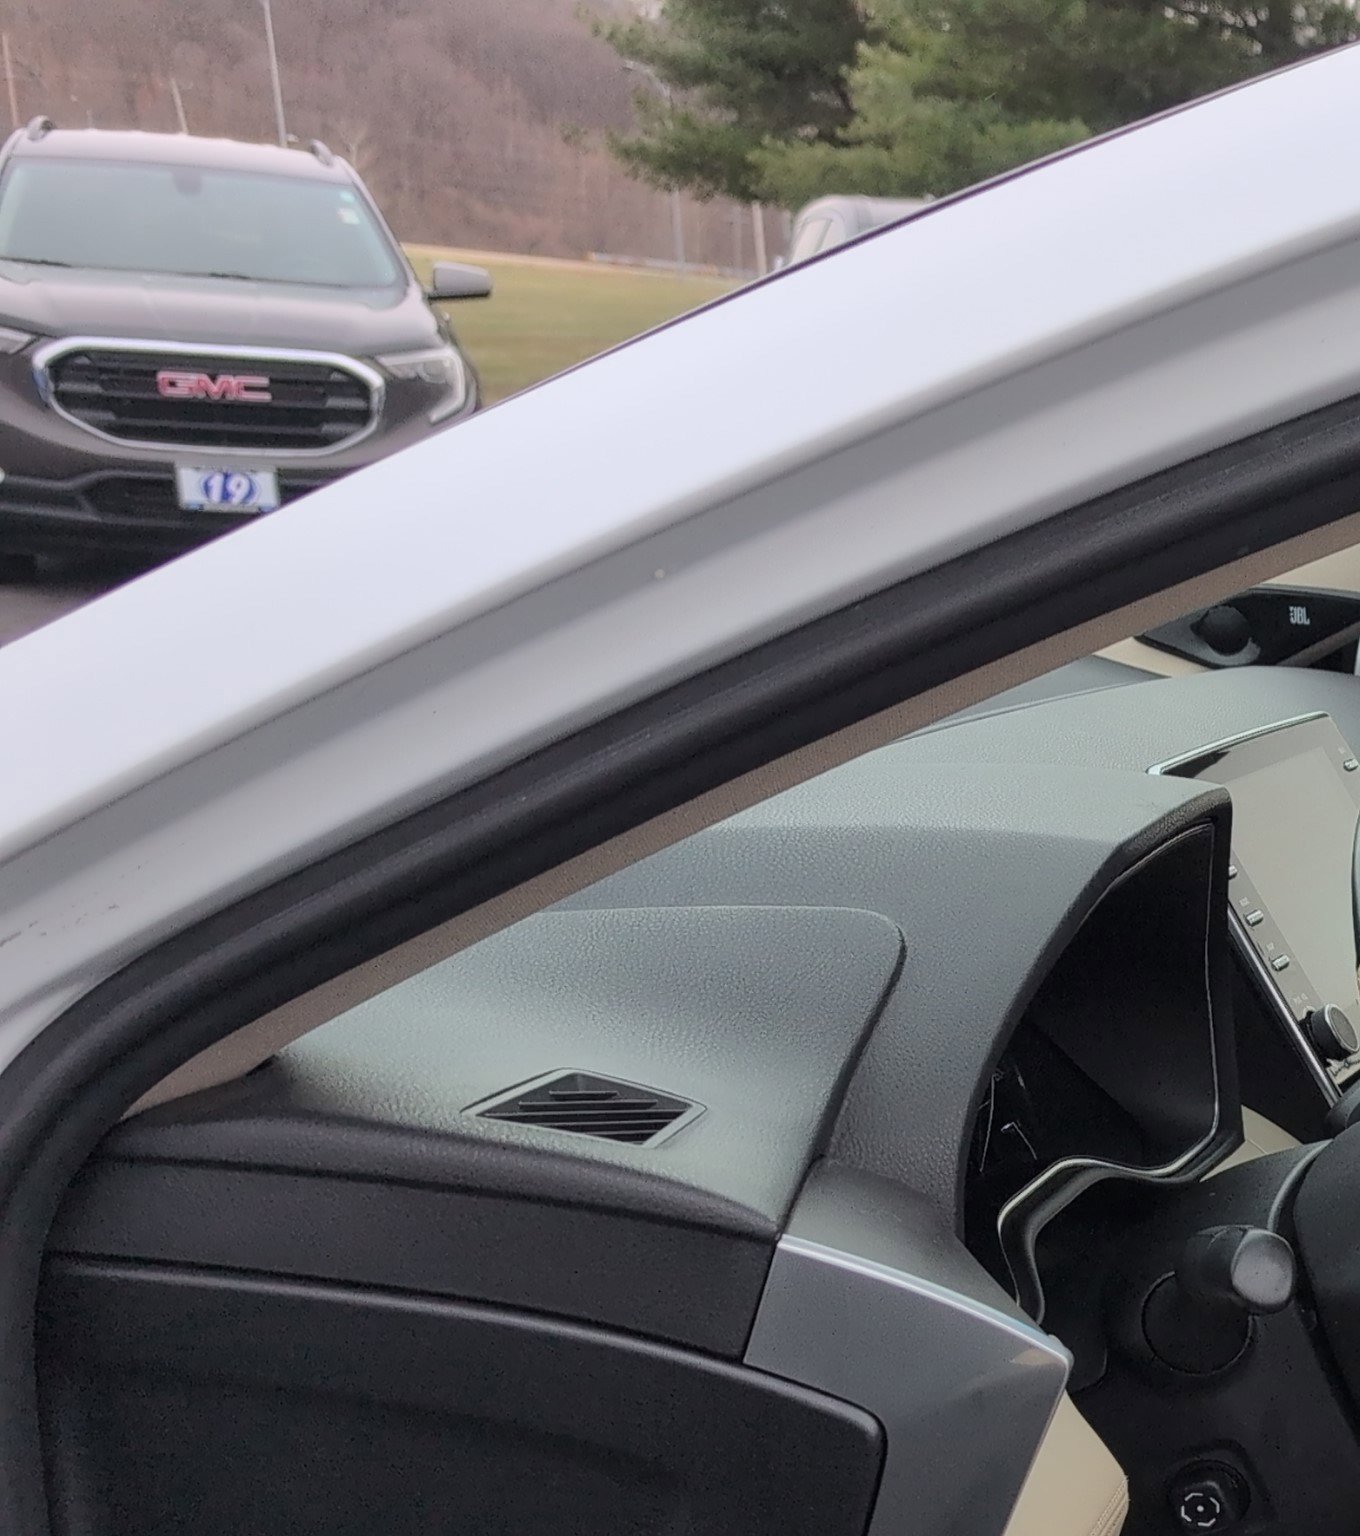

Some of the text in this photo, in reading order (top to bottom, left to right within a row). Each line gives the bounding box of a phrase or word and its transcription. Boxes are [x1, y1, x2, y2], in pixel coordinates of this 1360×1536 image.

[156, 367, 273, 404] GMC
[206, 470, 250, 506] 19
[1288, 605, 1311, 625] JBL
